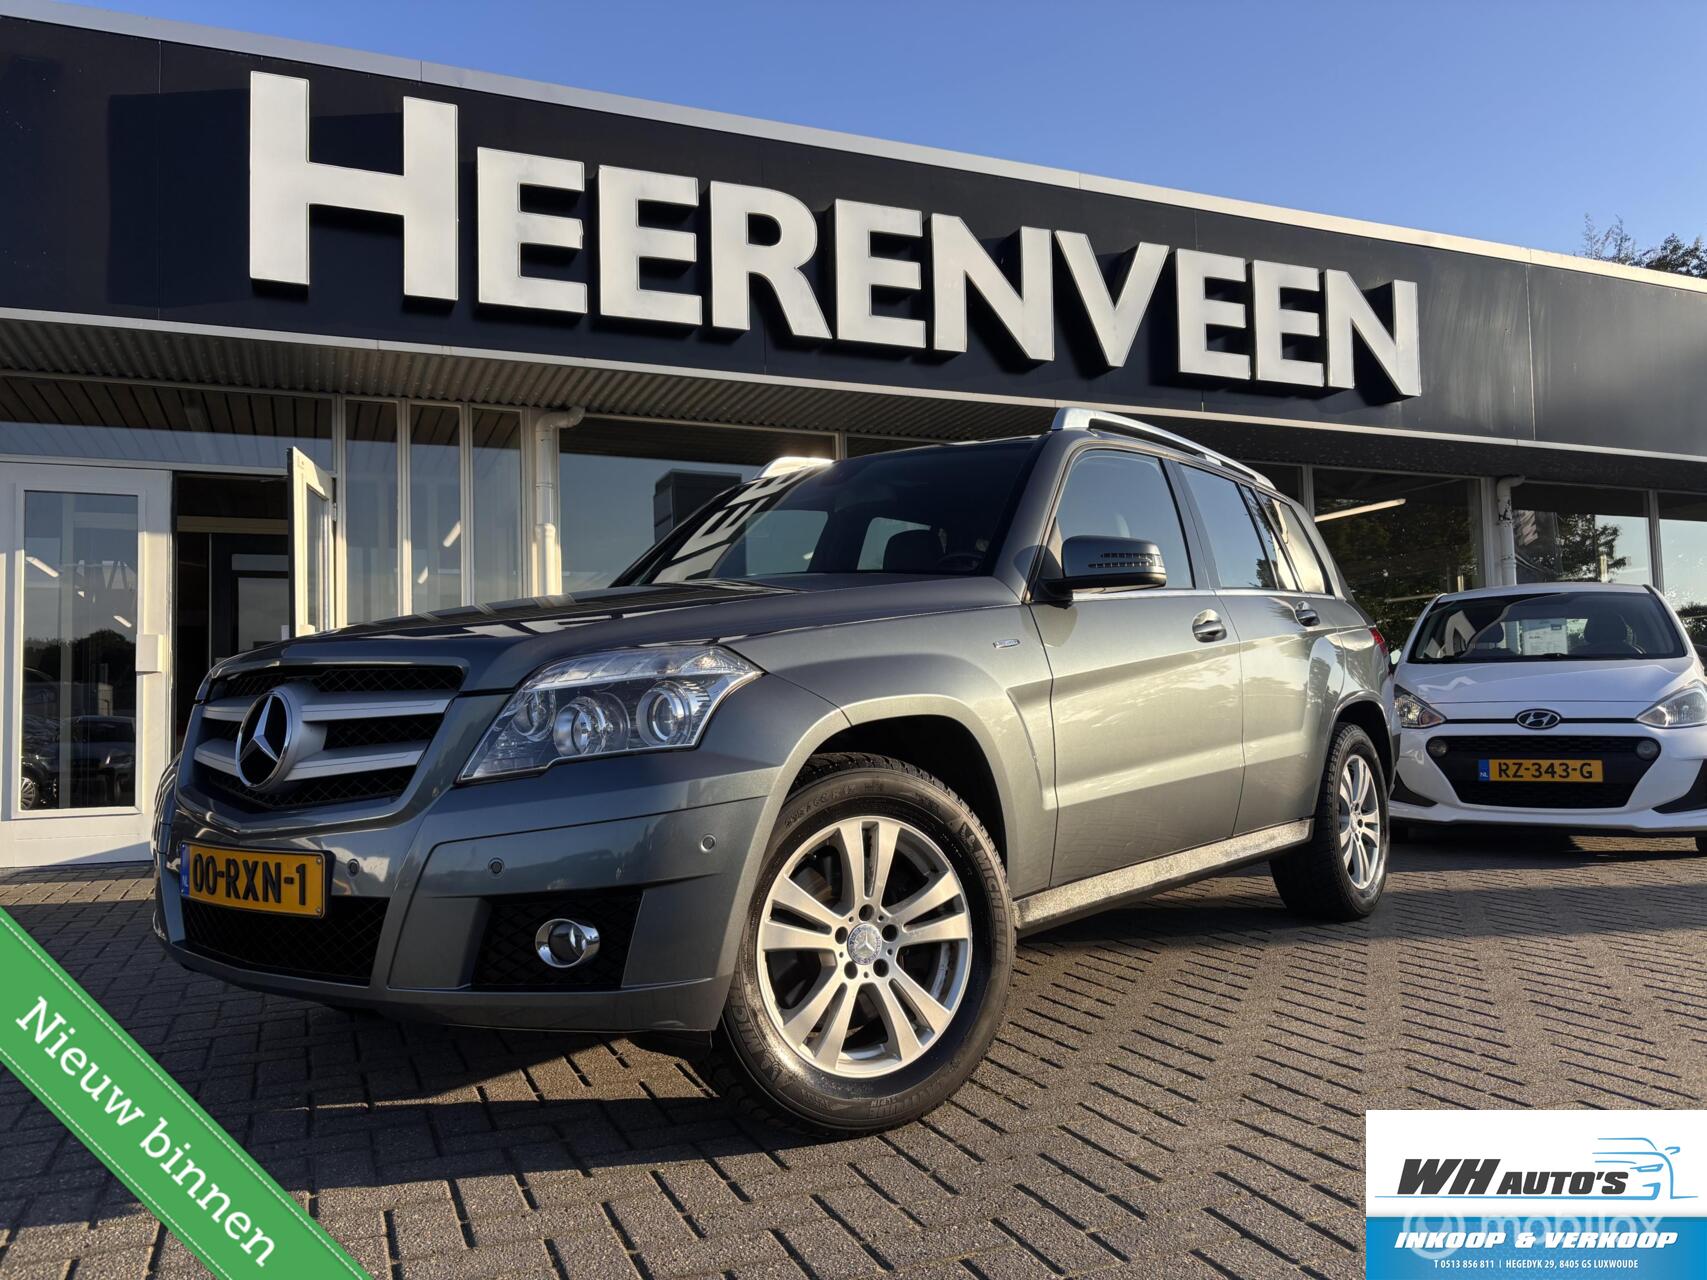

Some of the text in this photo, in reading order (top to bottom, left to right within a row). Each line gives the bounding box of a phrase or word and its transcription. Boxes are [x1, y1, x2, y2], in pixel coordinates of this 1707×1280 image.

[249, 70, 1422, 398] HEERENVEEN
[1498, 762, 1592, 779] RZ-343-G
[192, 853, 307, 906] 00-RXN-1
